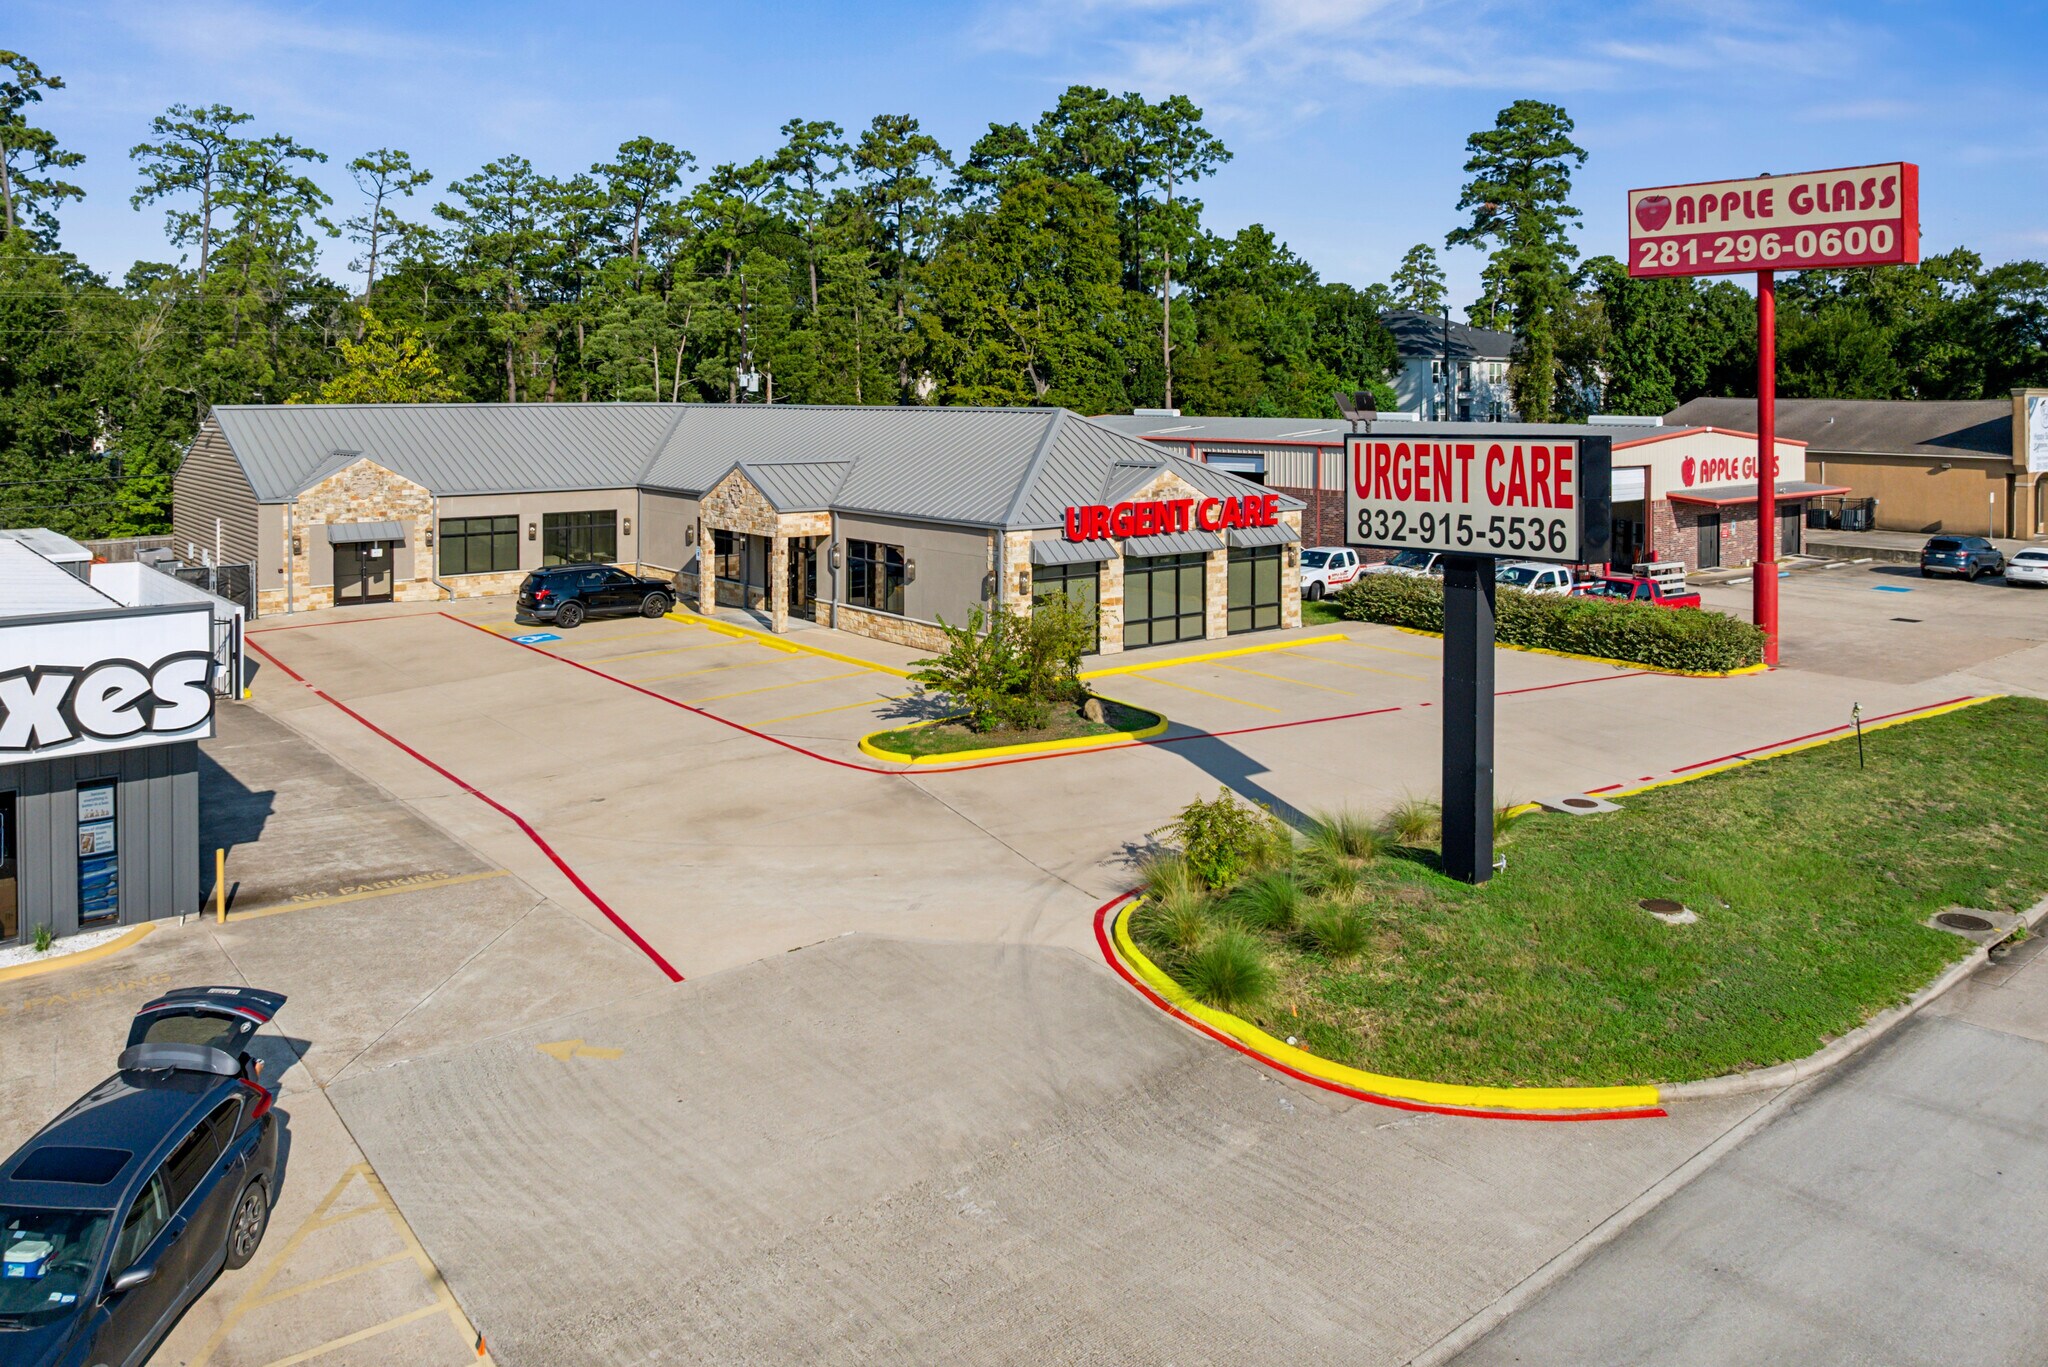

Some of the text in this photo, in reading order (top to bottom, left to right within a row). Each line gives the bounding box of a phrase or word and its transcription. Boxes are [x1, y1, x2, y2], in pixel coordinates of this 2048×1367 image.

[1676, 175, 1896, 225] APPLE GLASS
[1639, 225, 1894, 268] 281-296-0600
[1354, 442, 1574, 509] URGENT CARE
[1700, 455, 1780, 483] APPLE GLS
[1065, 494, 1279, 543] URGENT CARE
[1357, 508, 1567, 554] 832-915-5536
[291, 872, 449, 903] NO PARKING
